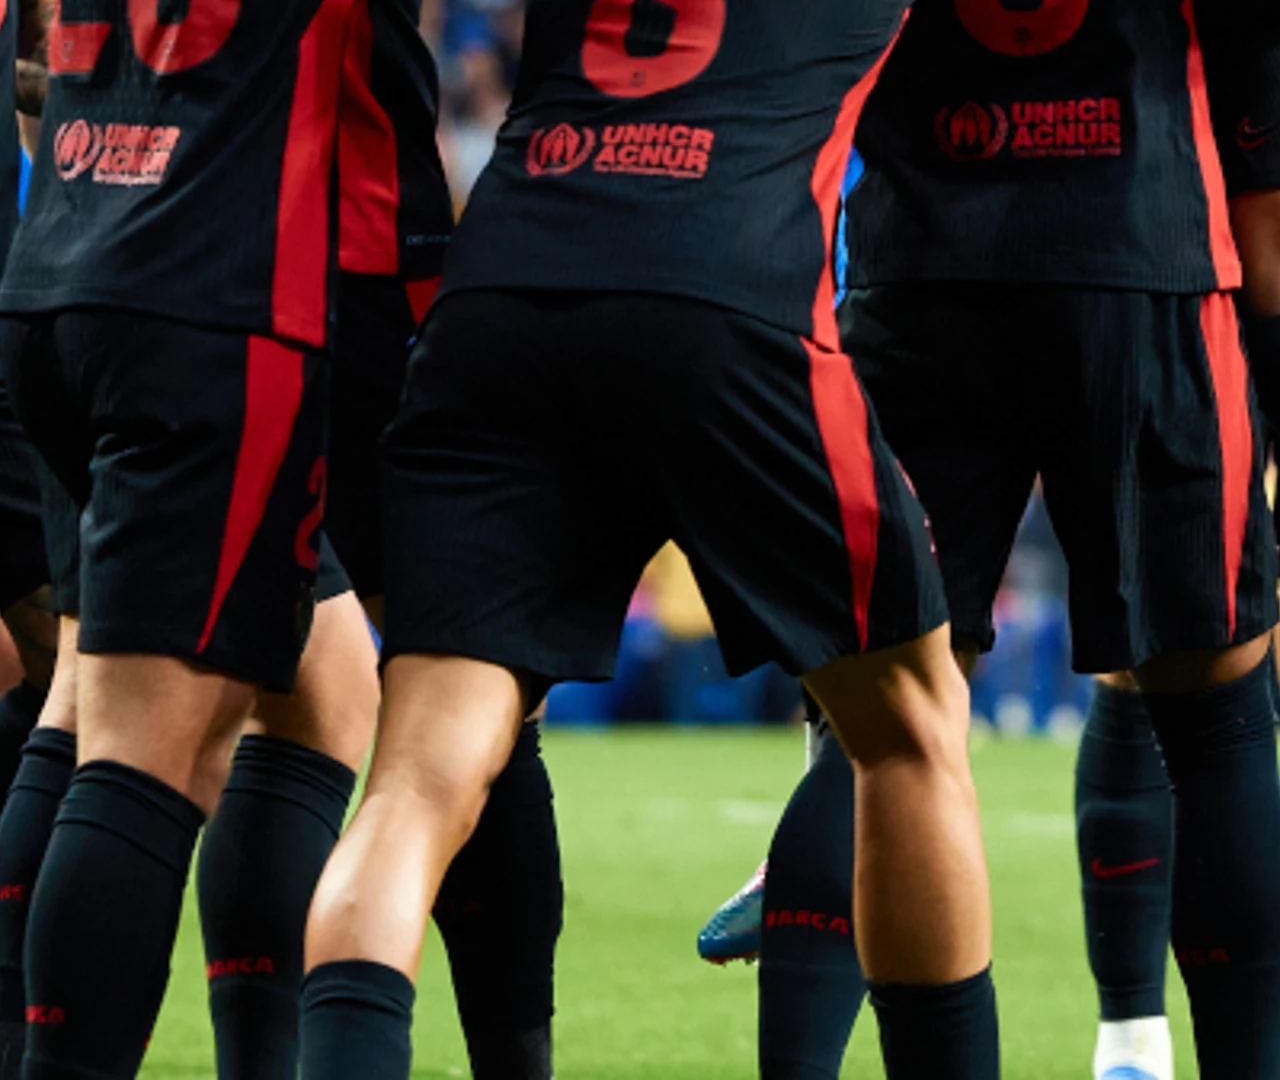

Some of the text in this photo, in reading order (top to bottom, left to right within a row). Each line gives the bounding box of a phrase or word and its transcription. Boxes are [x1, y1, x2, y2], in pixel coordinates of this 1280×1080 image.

[1011, 97, 1120, 125] UNHCR
[600, 122, 716, 152] UNHCR
[1012, 122, 1120, 148] ACNUR
[594, 143, 710, 172] ACNUR
